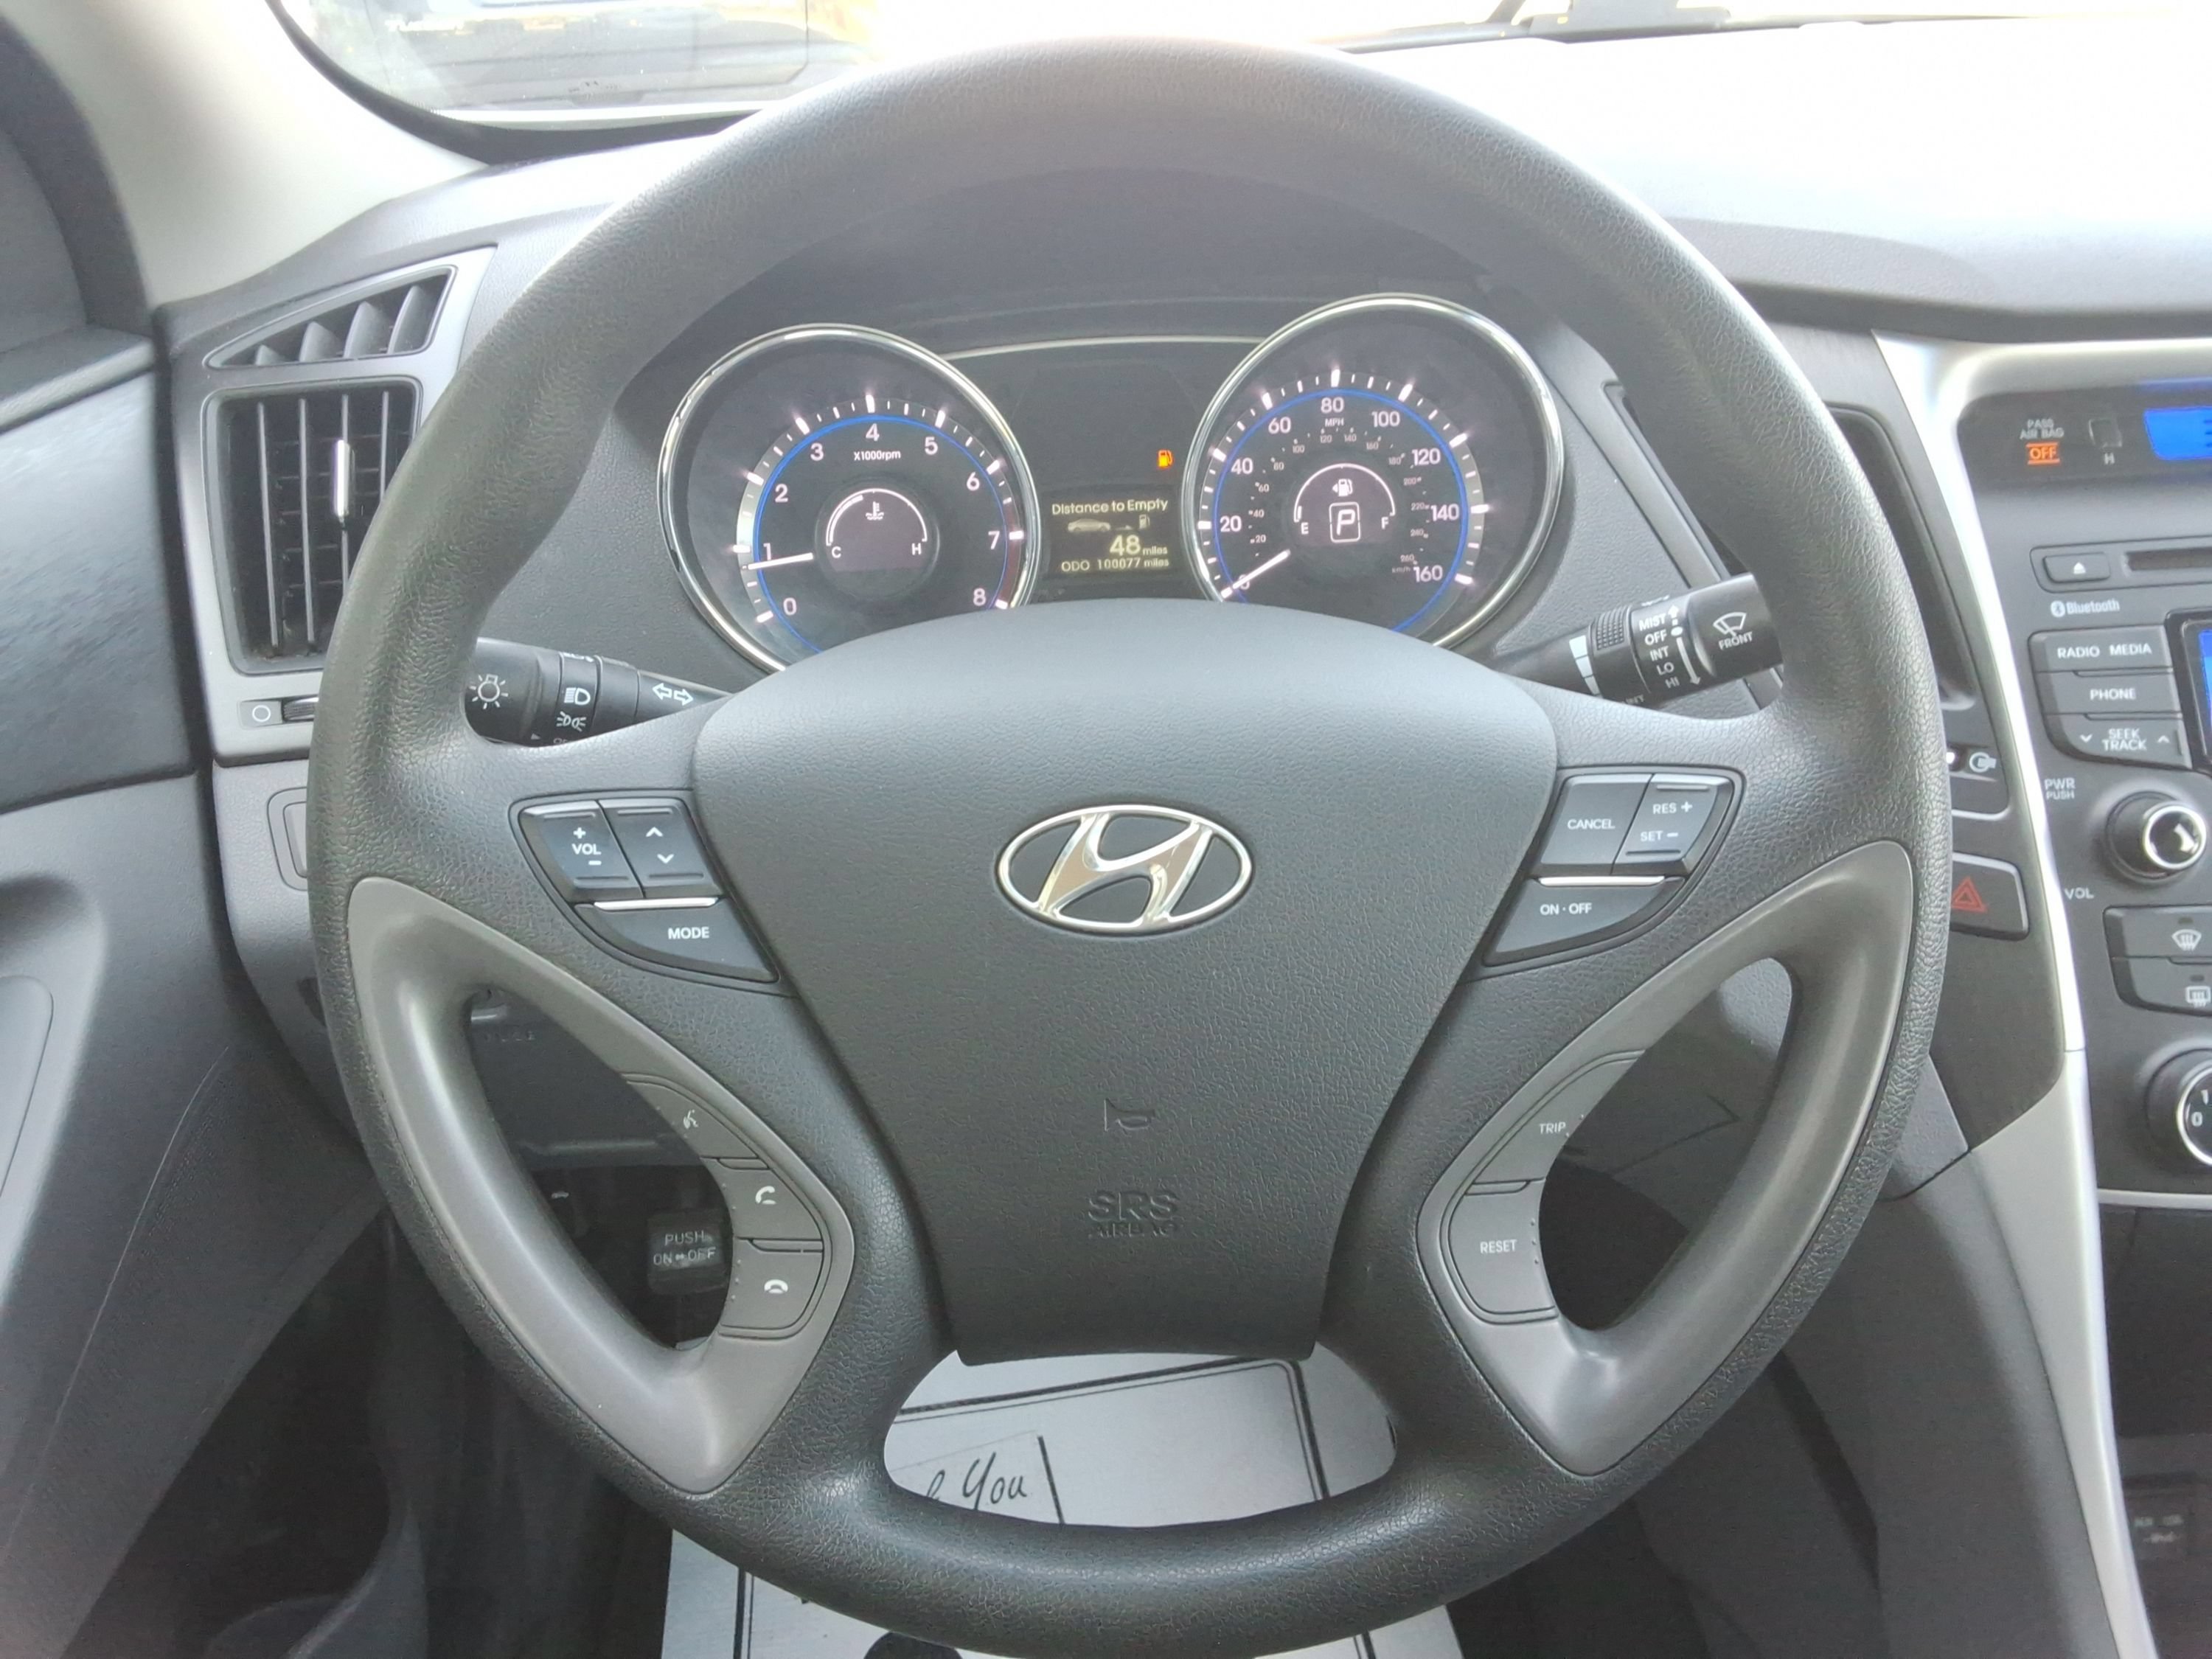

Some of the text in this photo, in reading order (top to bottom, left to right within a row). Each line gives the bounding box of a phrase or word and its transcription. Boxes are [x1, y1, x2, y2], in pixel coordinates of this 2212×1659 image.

[1321, 397, 1344, 414] 80
[1268, 417, 1291, 434] 60
[1325, 417, 1344, 427] MPH
[1371, 411, 1400, 428] 100
[866, 424, 880, 441] 4
[811, 444, 824, 461] 3
[925, 438, 938, 455] 5
[2030, 447, 2057, 459] OFF
[854, 449, 901, 461] X1000rpm
[1412, 448, 1441, 466] 120
[1231, 457, 1253, 475] 40
[967, 474, 980, 490] 6
[775, 485, 788, 502] 2
[1052, 498, 1168, 515] Distance to Empty
[1430, 504, 1459, 521] 140
[1220, 515, 1242, 532] 20
[1301, 522, 1309, 535] E
[1337, 509, 1355, 535] P
[1381, 517, 1389, 529] F
[988, 532, 1000, 549] 7
[1110, 535, 1168, 556] 48 miles
[763, 543, 772, 560] 1
[832, 546, 841, 559] C
[911, 543, 922, 555] H
[1061, 560, 1090, 572] ODO
[1144, 558, 1169, 568] miles
[1413, 565, 1443, 582] 160
[973, 589, 987, 606] 8
[784, 599, 797, 615] 0
[2066, 598, 2121, 615] Bluetooth
[1638, 613, 1666, 631] MIST
[1645, 629, 1667, 645] OFF
[1719, 632, 1753, 650] FRONT
[1650, 646, 1669, 661] INT
[2057, 643, 2152, 658] RADIO MEDIA
[1657, 661, 1674, 675] LO
[1665, 677, 1680, 689] HI
[2090, 687, 2136, 700] PHONE
[2108, 728, 2140, 739] SEEK
[2102, 739, 2147, 751] TRACK
[2045, 777, 2076, 790] PWR
[2046, 790, 2075, 800] PUSH
[1653, 803, 1677, 814] RES
[1568, 818, 1615, 830] CANCEL
[1641, 831, 1663, 842] SET
[572, 843, 602, 855] VOL
[2065, 887, 2094, 900] VOL
[668, 926, 709, 939] MODE
[2191, 1111, 2203, 1127] 0
[1540, 1121, 1566, 1135] TRIP
[1088, 1192, 1180, 1222] SRS
[664, 1229, 704, 1246] PUSH
[1480, 1239, 1517, 1253] RESET
[962, 1451, 1027, 1510] You
